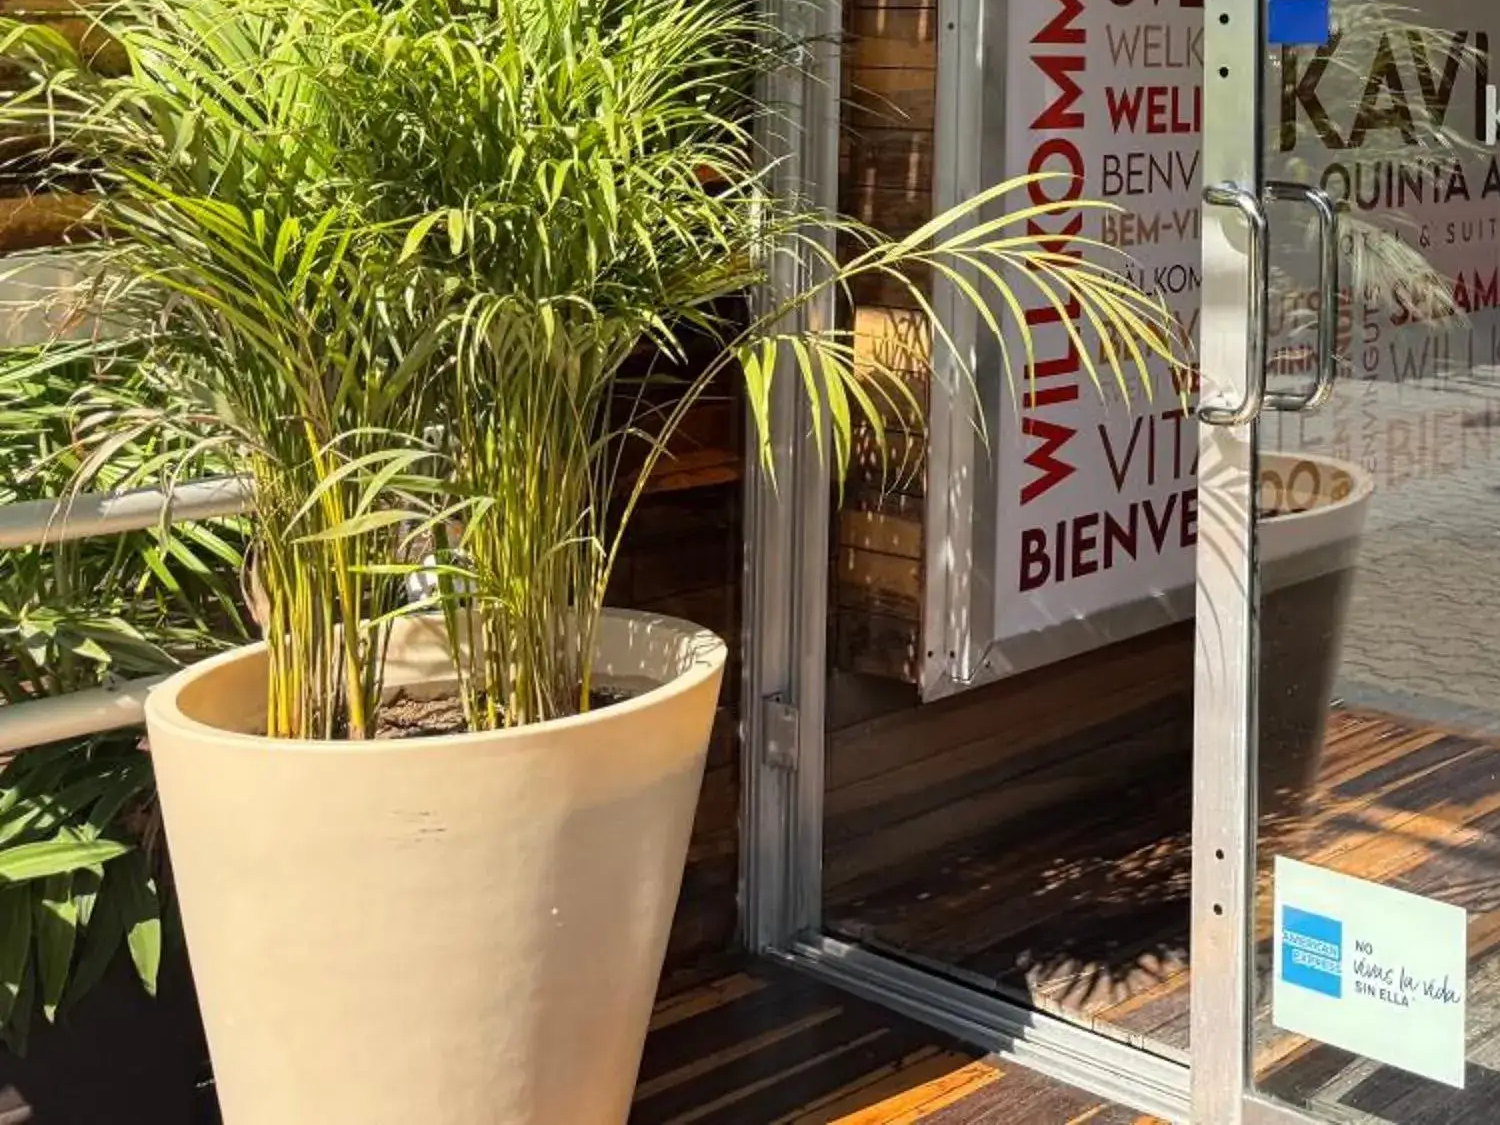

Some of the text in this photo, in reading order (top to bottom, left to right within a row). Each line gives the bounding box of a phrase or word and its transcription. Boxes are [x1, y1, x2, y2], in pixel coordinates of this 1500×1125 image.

[1319, 158, 1470, 213] QUINTA
[1100, 207, 1201, 248] BEM-VI
[1355, 939, 1374, 956] NO
[1354, 980, 1409, 1008] SIN ELLA
[1399, 965, 1420, 993] la
[1422, 973, 1462, 1004] vida
